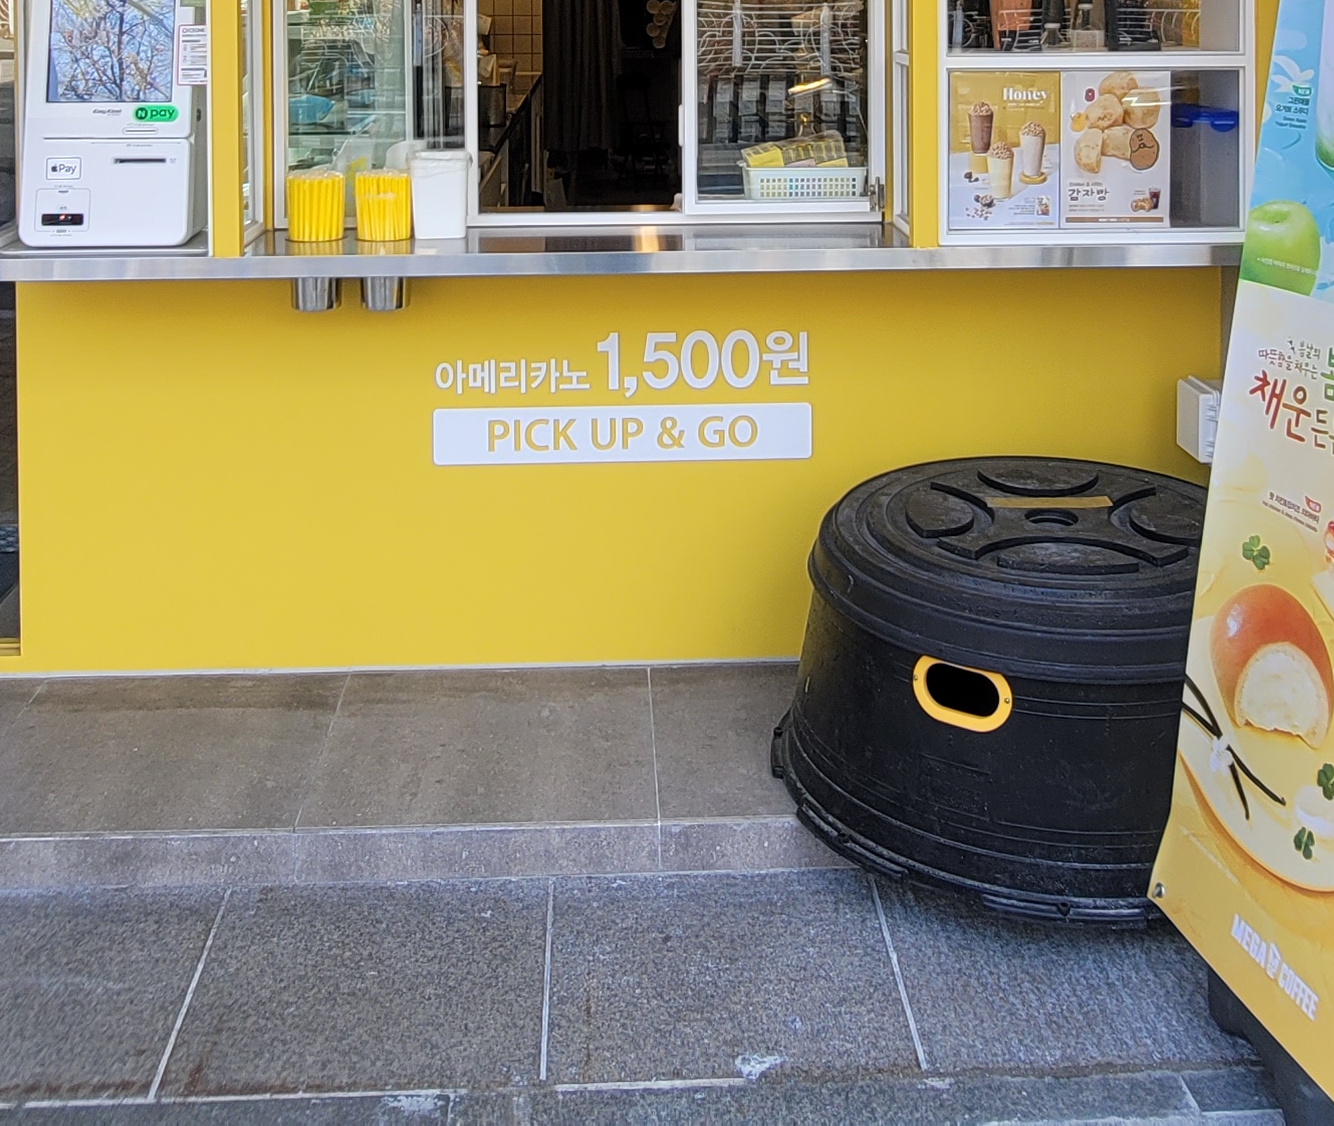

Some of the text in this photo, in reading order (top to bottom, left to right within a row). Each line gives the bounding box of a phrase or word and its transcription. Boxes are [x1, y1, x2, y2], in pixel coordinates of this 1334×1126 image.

[150, 109, 175, 119] pay
[58, 163, 77, 175] Pay
[434, 329, 809, 398] 아메리카노 1,500원
[487, 415, 758, 452] PICK UP & GO
[1231, 913, 1319, 1022] MEGA COFFEE
